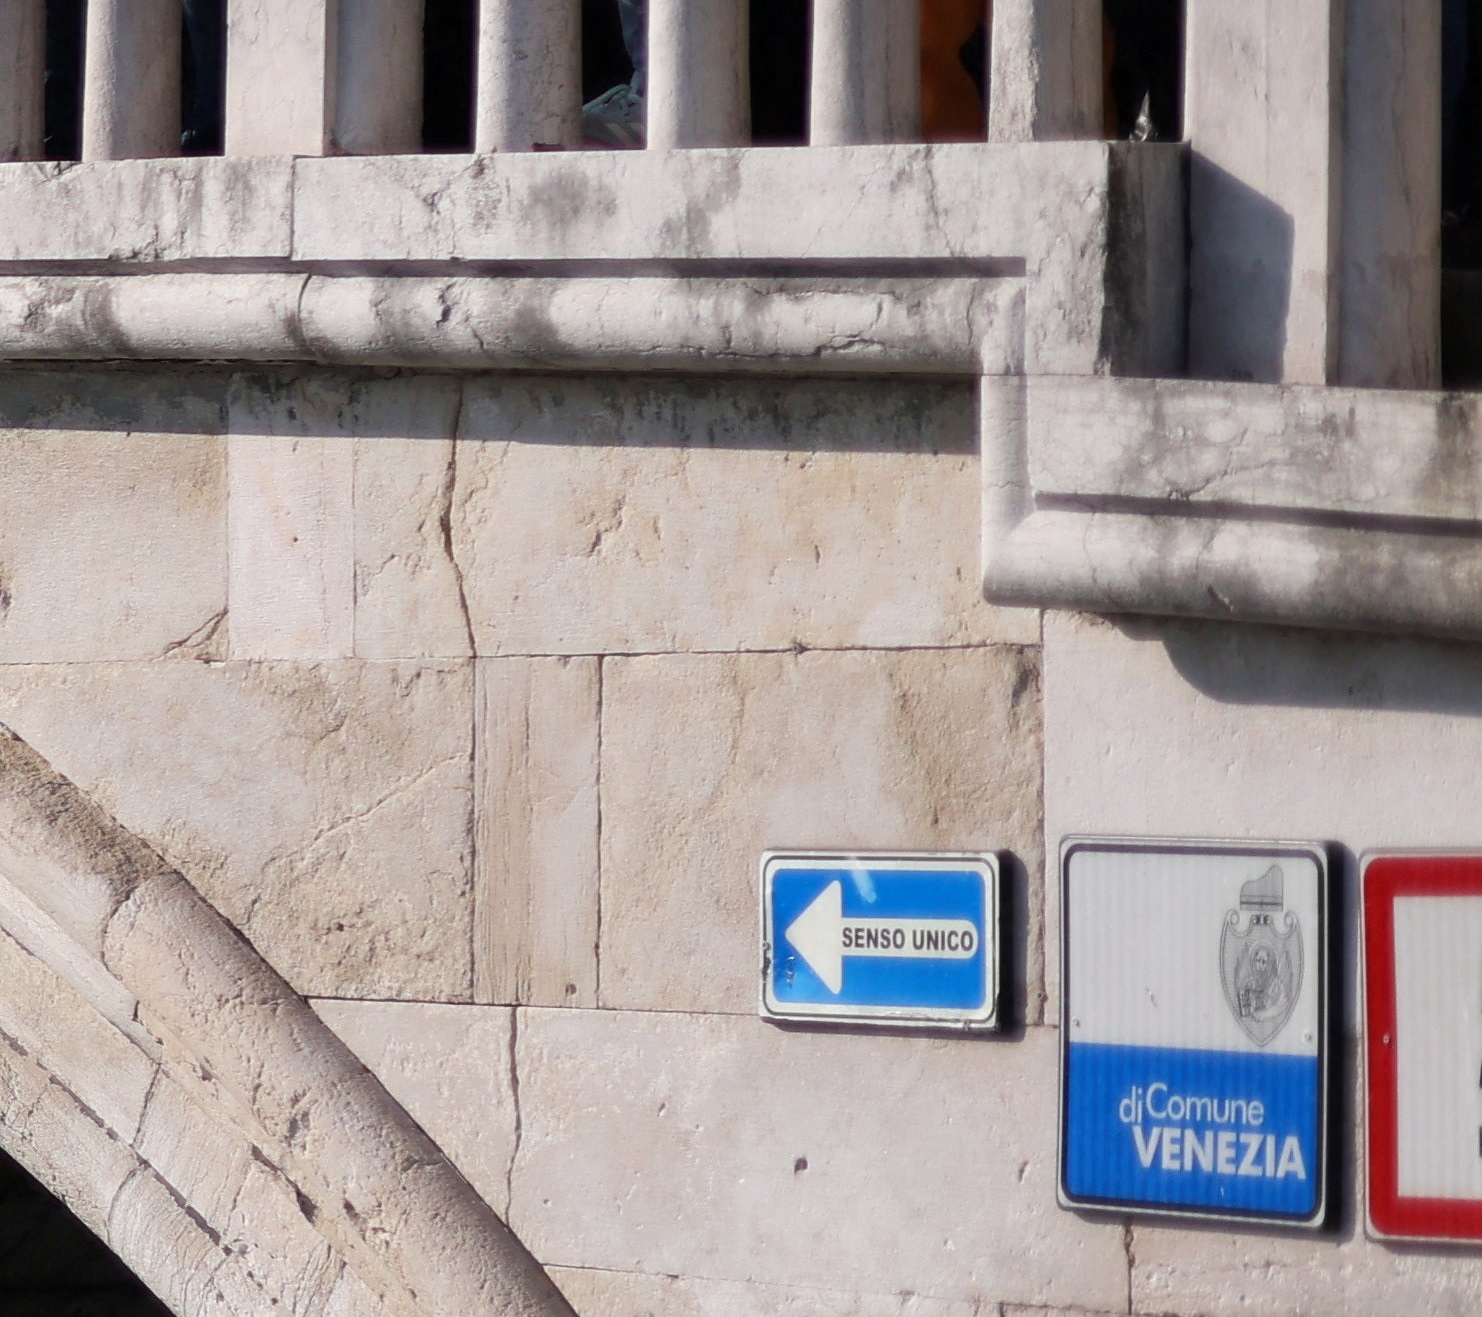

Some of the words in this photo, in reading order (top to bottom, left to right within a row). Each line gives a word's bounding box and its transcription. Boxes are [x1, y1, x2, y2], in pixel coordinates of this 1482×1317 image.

[842, 927, 905, 949] SENSO
[912, 929, 974, 952] UNICO
[1119, 1085, 1143, 1123] di
[1146, 1082, 1265, 1126] Comune
[1132, 1125, 1307, 1180] VENEZIA
